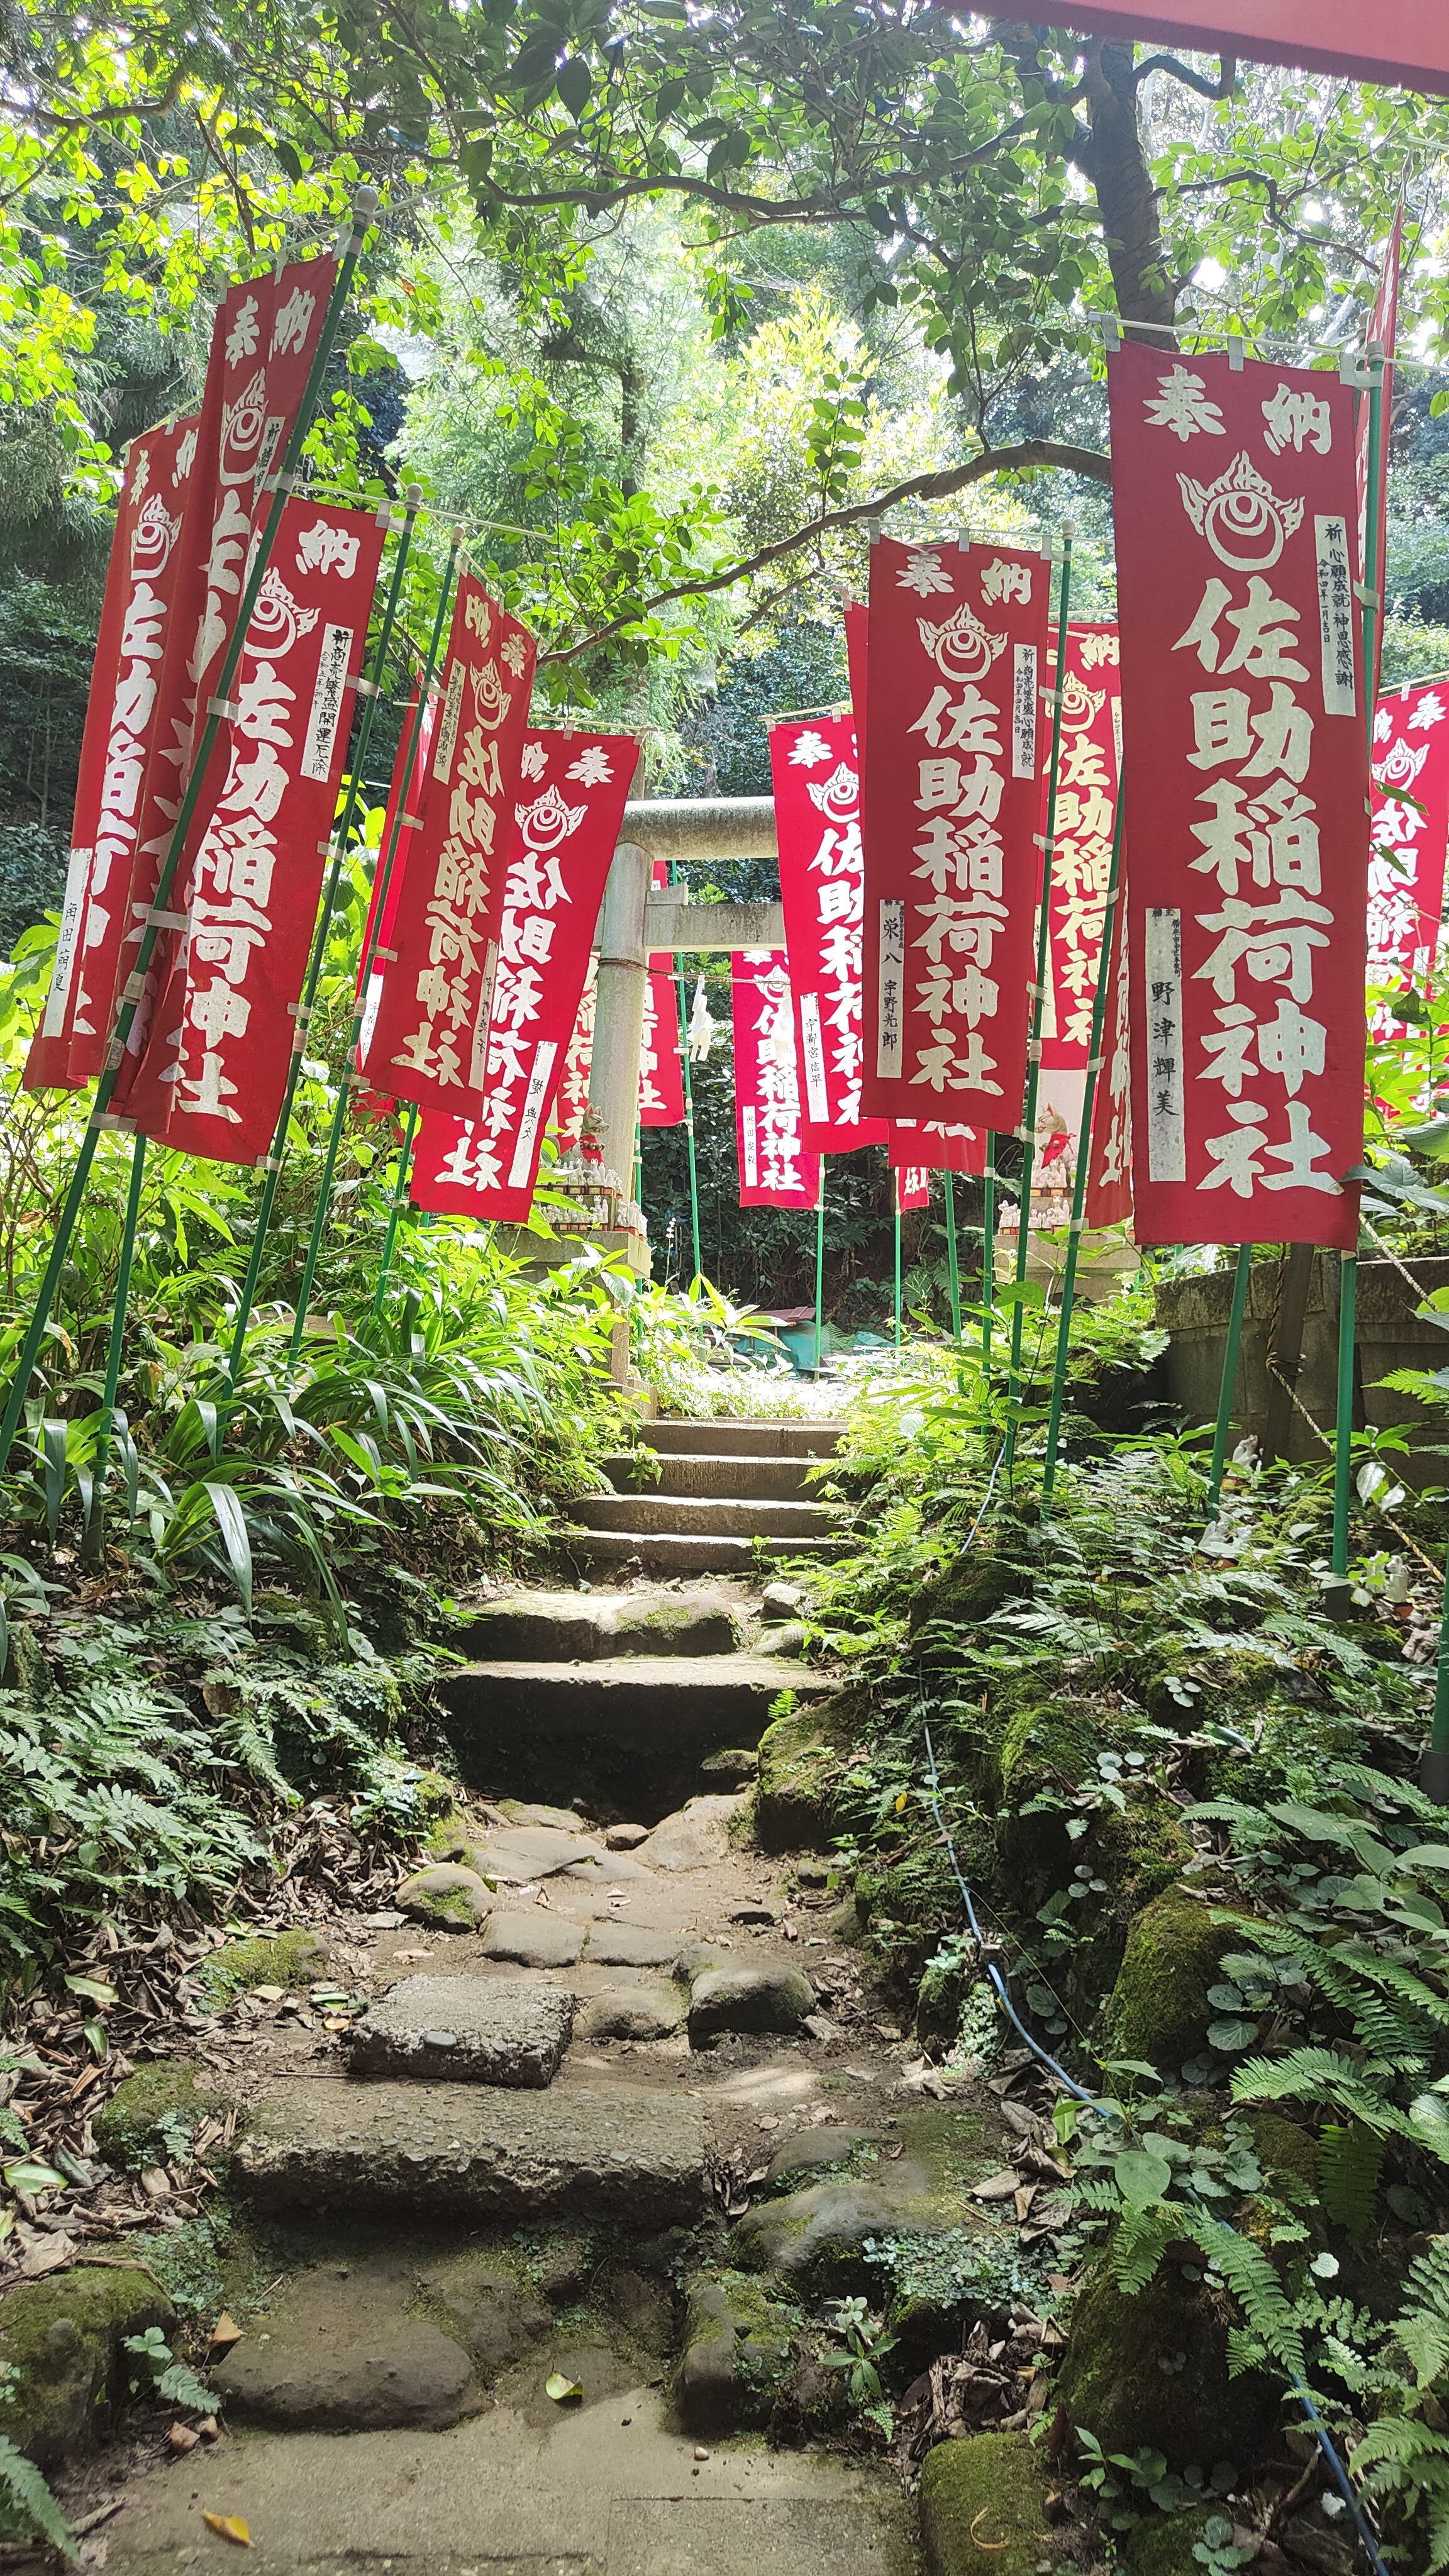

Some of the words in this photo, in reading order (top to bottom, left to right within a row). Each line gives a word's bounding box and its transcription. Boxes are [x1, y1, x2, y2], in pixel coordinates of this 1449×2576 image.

[223, 286, 316, 371] 奉納
[1143, 364, 1331, 455] 奉納
[896, 552, 1032, 606] 奉納
[906, 684, 1009, 1096] 佐助稲荷神社
[1171, 575, 1345, 1198] 佐助稲荷神社
[1151, 981, 1180, 1116] 野津輝美
